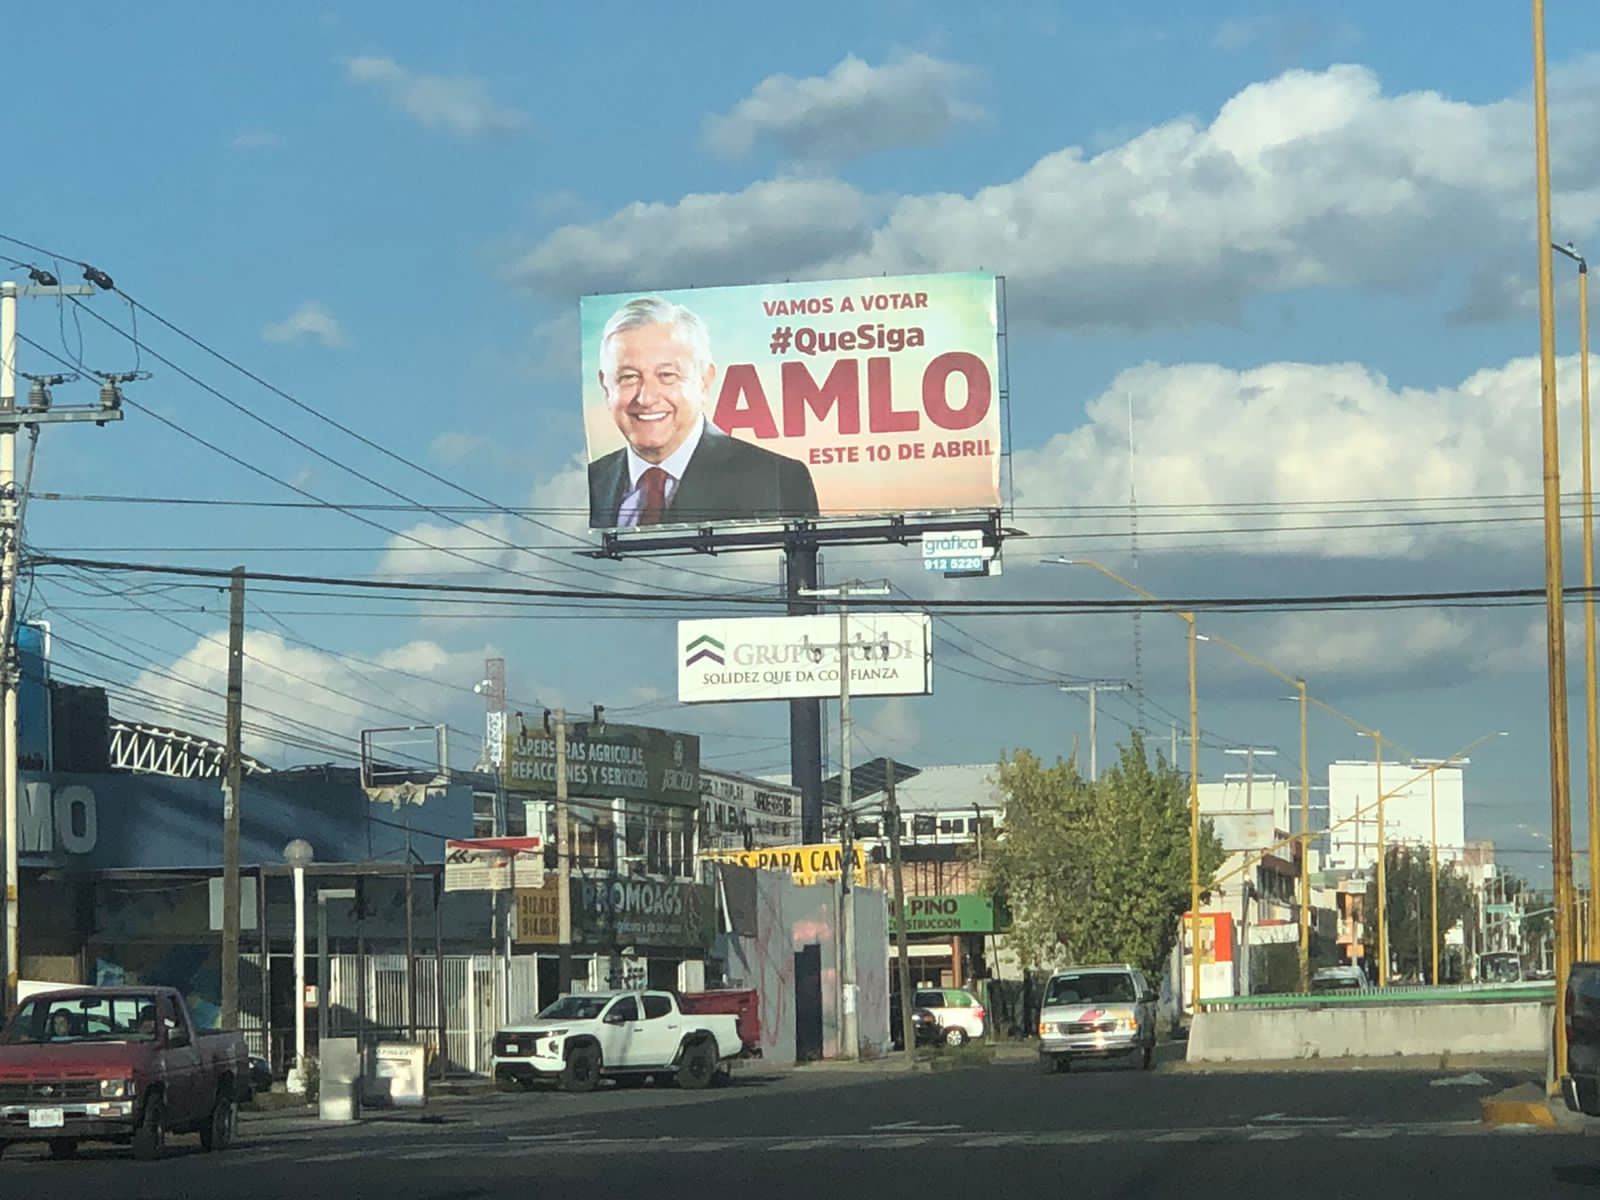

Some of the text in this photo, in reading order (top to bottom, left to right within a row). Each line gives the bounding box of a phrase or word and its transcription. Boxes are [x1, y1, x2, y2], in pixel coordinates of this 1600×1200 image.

[763, 293, 928, 316] VAMOS A VOTAR
[770, 325, 924, 355] #QueSiga
[713, 352, 991, 439] AMLO
[809, 440, 994, 464] ESTE 10 DE ABRIL
[924, 559, 947, 570] 912
[703, 668, 898, 684] SOLIDEZ QUE DA COFIANZA
[512, 739, 585, 761] ASPERSRAS
[591, 766, 598, 784] Y
[911, 899, 958, 915] PINO
